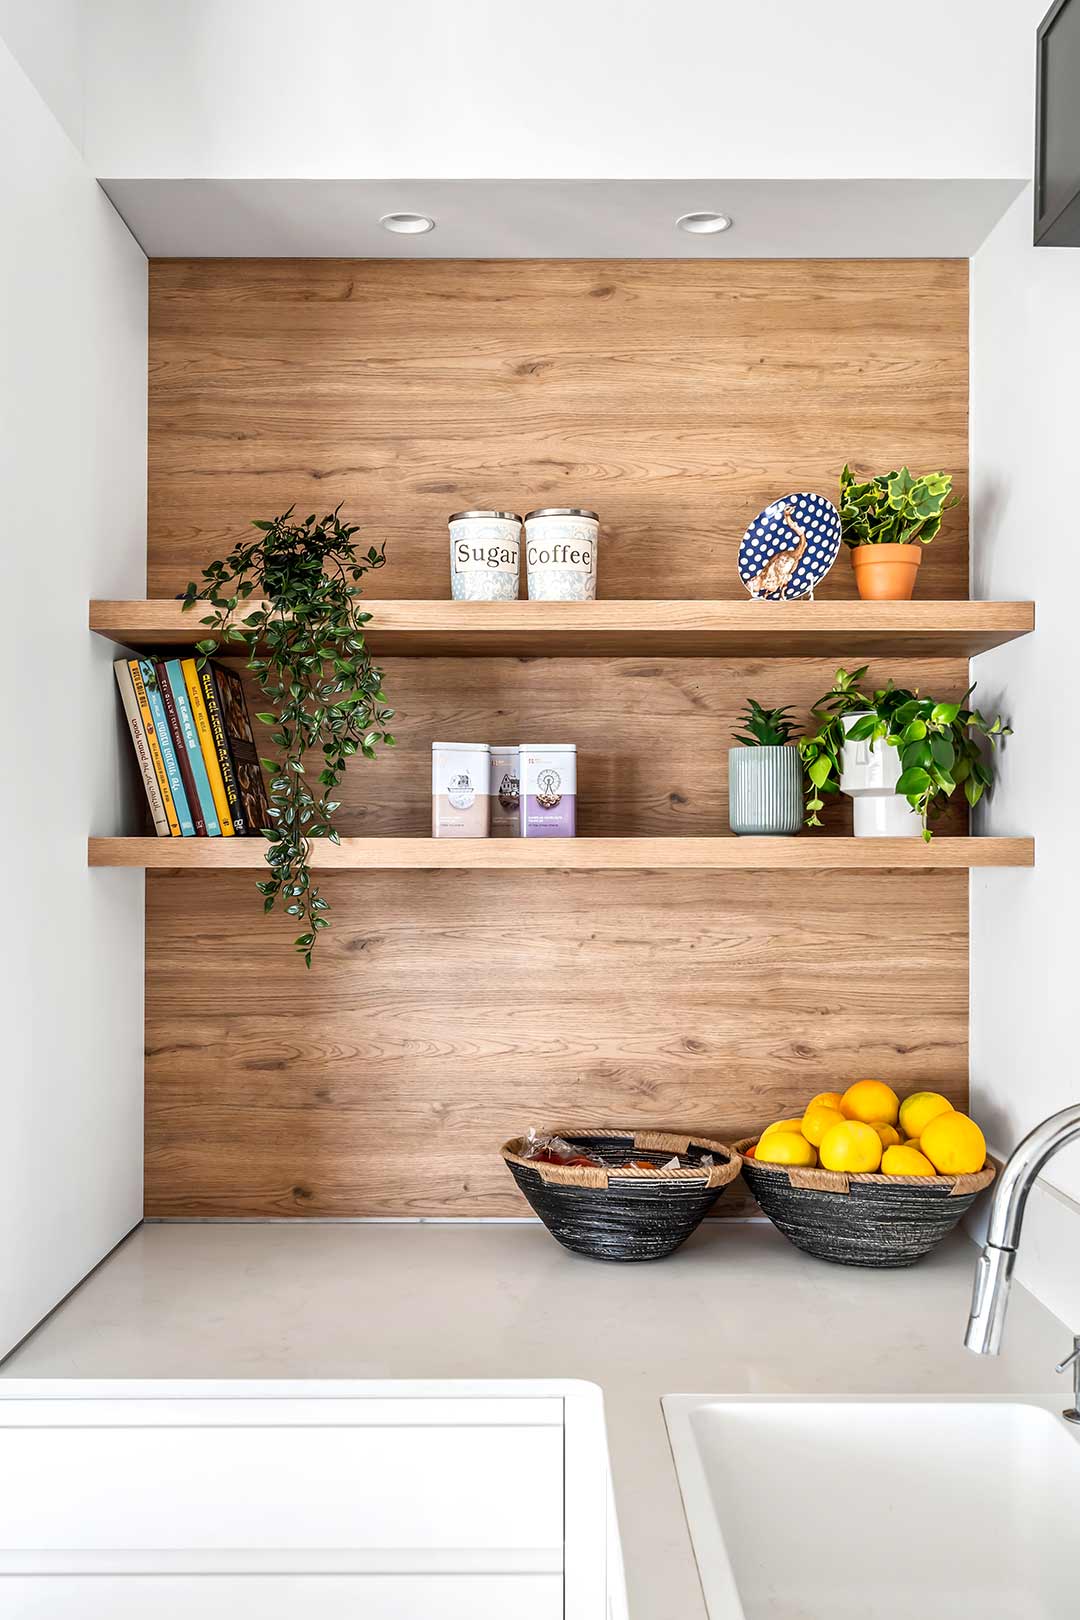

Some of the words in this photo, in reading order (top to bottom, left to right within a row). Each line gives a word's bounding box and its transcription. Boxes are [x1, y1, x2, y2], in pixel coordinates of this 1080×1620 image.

[457, 544, 518, 568] Sugar
[528, 545, 590, 566] Coffee
[201, 674, 214, 700] סודות
[208, 701, 218, 712] מן
[131, 718, 143, 739] האוסף
[157, 721, 170, 746] המטבח
[211, 713, 226, 746] המטבח
[137, 739, 149, 761] המתוק
[216, 748, 229, 762] של
[142, 762, 150, 772] של
[163, 748, 177, 775] הטבעוני
[221, 762, 233, 782] נירה
[170, 777, 181, 791] שלי
